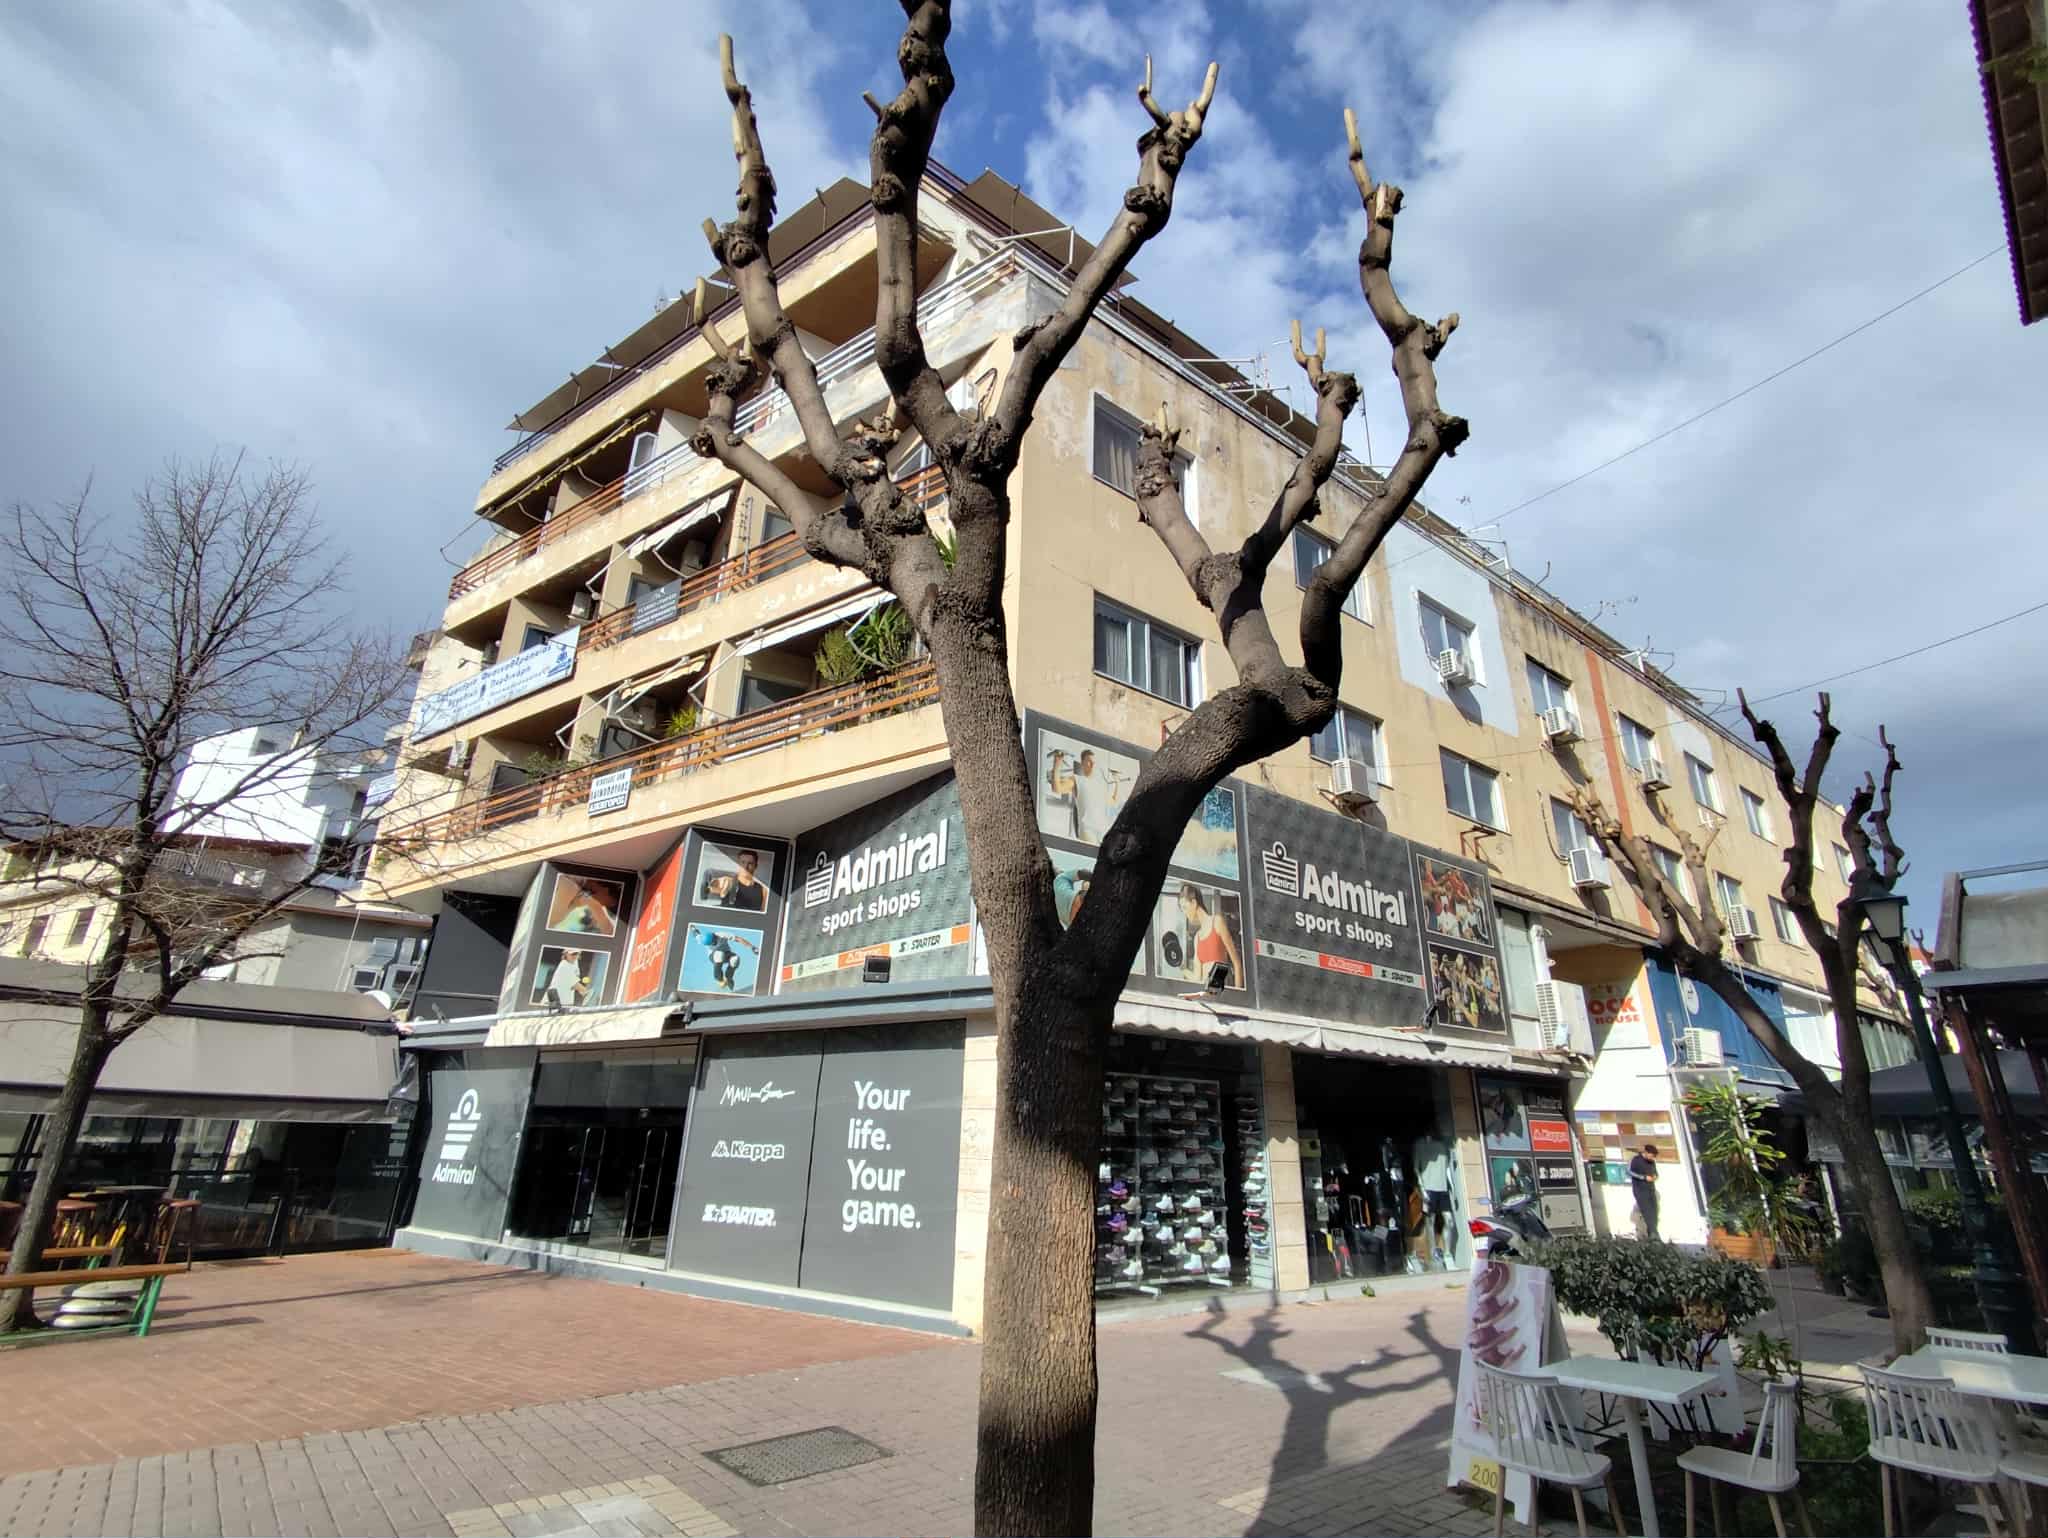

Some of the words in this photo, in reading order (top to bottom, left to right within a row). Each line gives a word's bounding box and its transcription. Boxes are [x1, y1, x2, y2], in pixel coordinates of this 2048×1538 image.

[832, 818, 948, 899] Admiral
[1302, 863, 1408, 926] Admiral
[822, 901, 864, 936] sport
[867, 889, 921, 918] shops
[1295, 911, 1342, 936] sport
[1346, 921, 1393, 949] shops
[1588, 997, 1637, 1015] OCK
[1595, 1014, 1640, 1024] HOUSE
[854, 1080, 911, 1111] Your
[847, 1118, 891, 1150] life.
[730, 1140, 785, 1162] Kappa
[432, 1163, 477, 1185] Admiral
[847, 1158, 906, 1192] Your
[842, 1199, 921, 1232] game.
